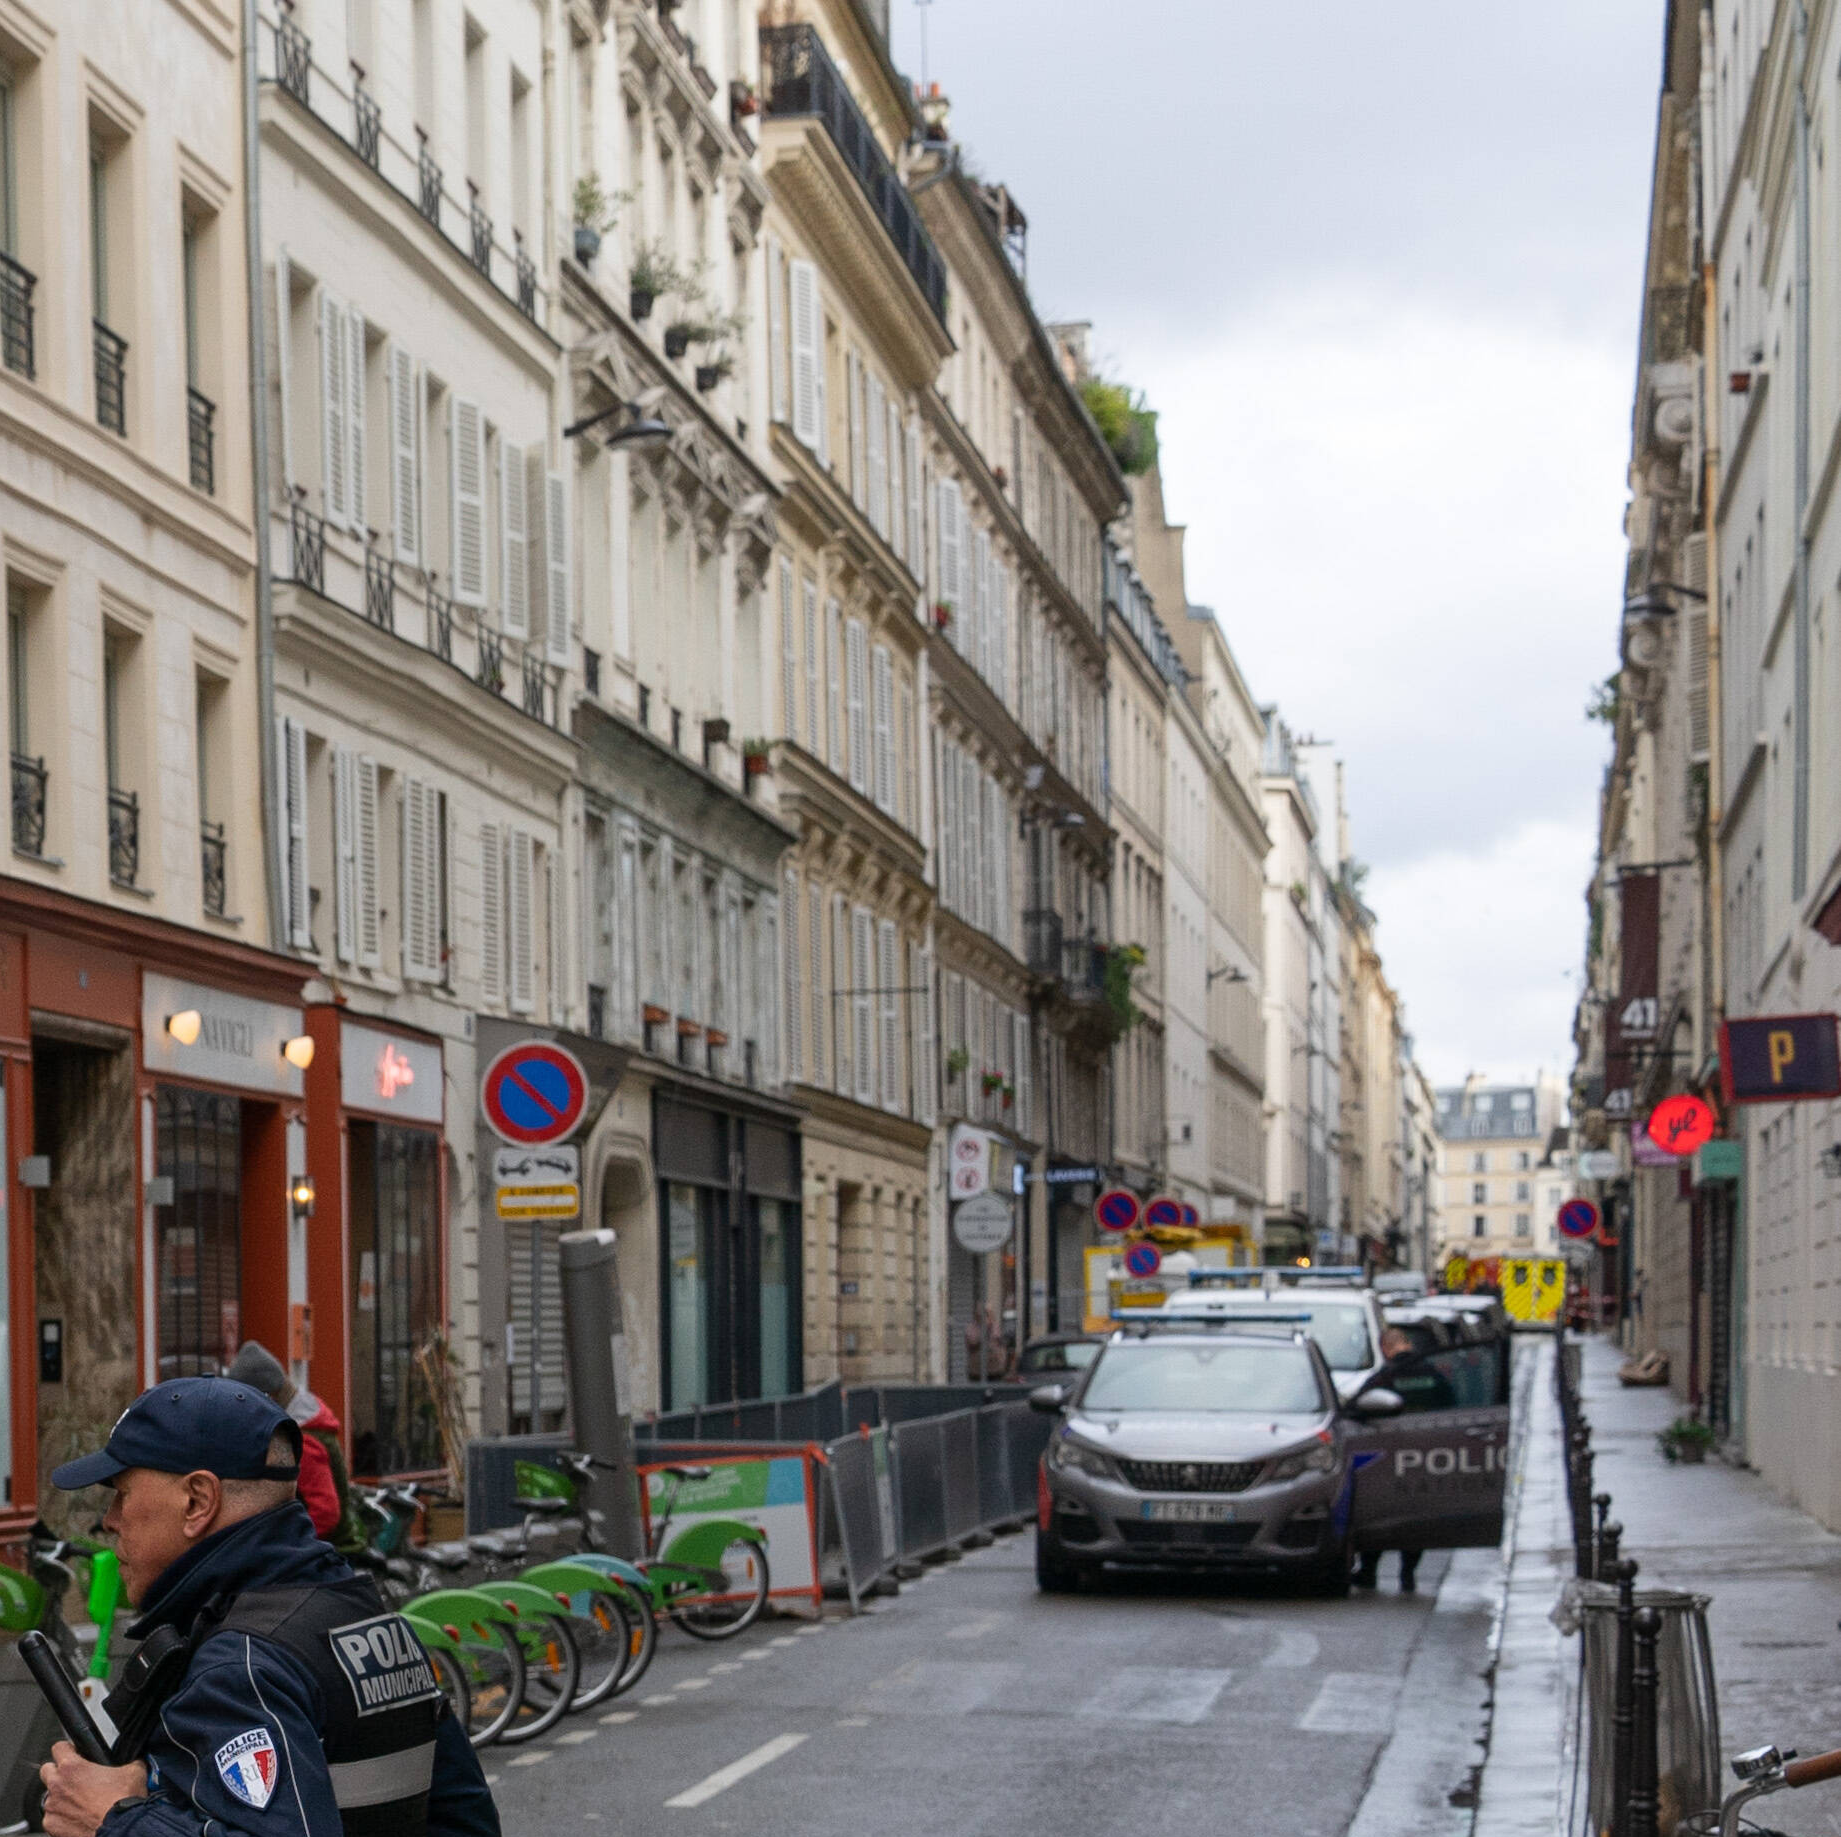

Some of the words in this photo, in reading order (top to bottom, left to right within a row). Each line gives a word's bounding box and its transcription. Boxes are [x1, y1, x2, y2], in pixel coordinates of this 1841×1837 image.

[1621, 997, 1657, 1027] 41
[1768, 1030, 1795, 1084] P
[217, 1730, 266, 1763] POLICE
[220, 1739, 269, 1769] MUNICIPALE
